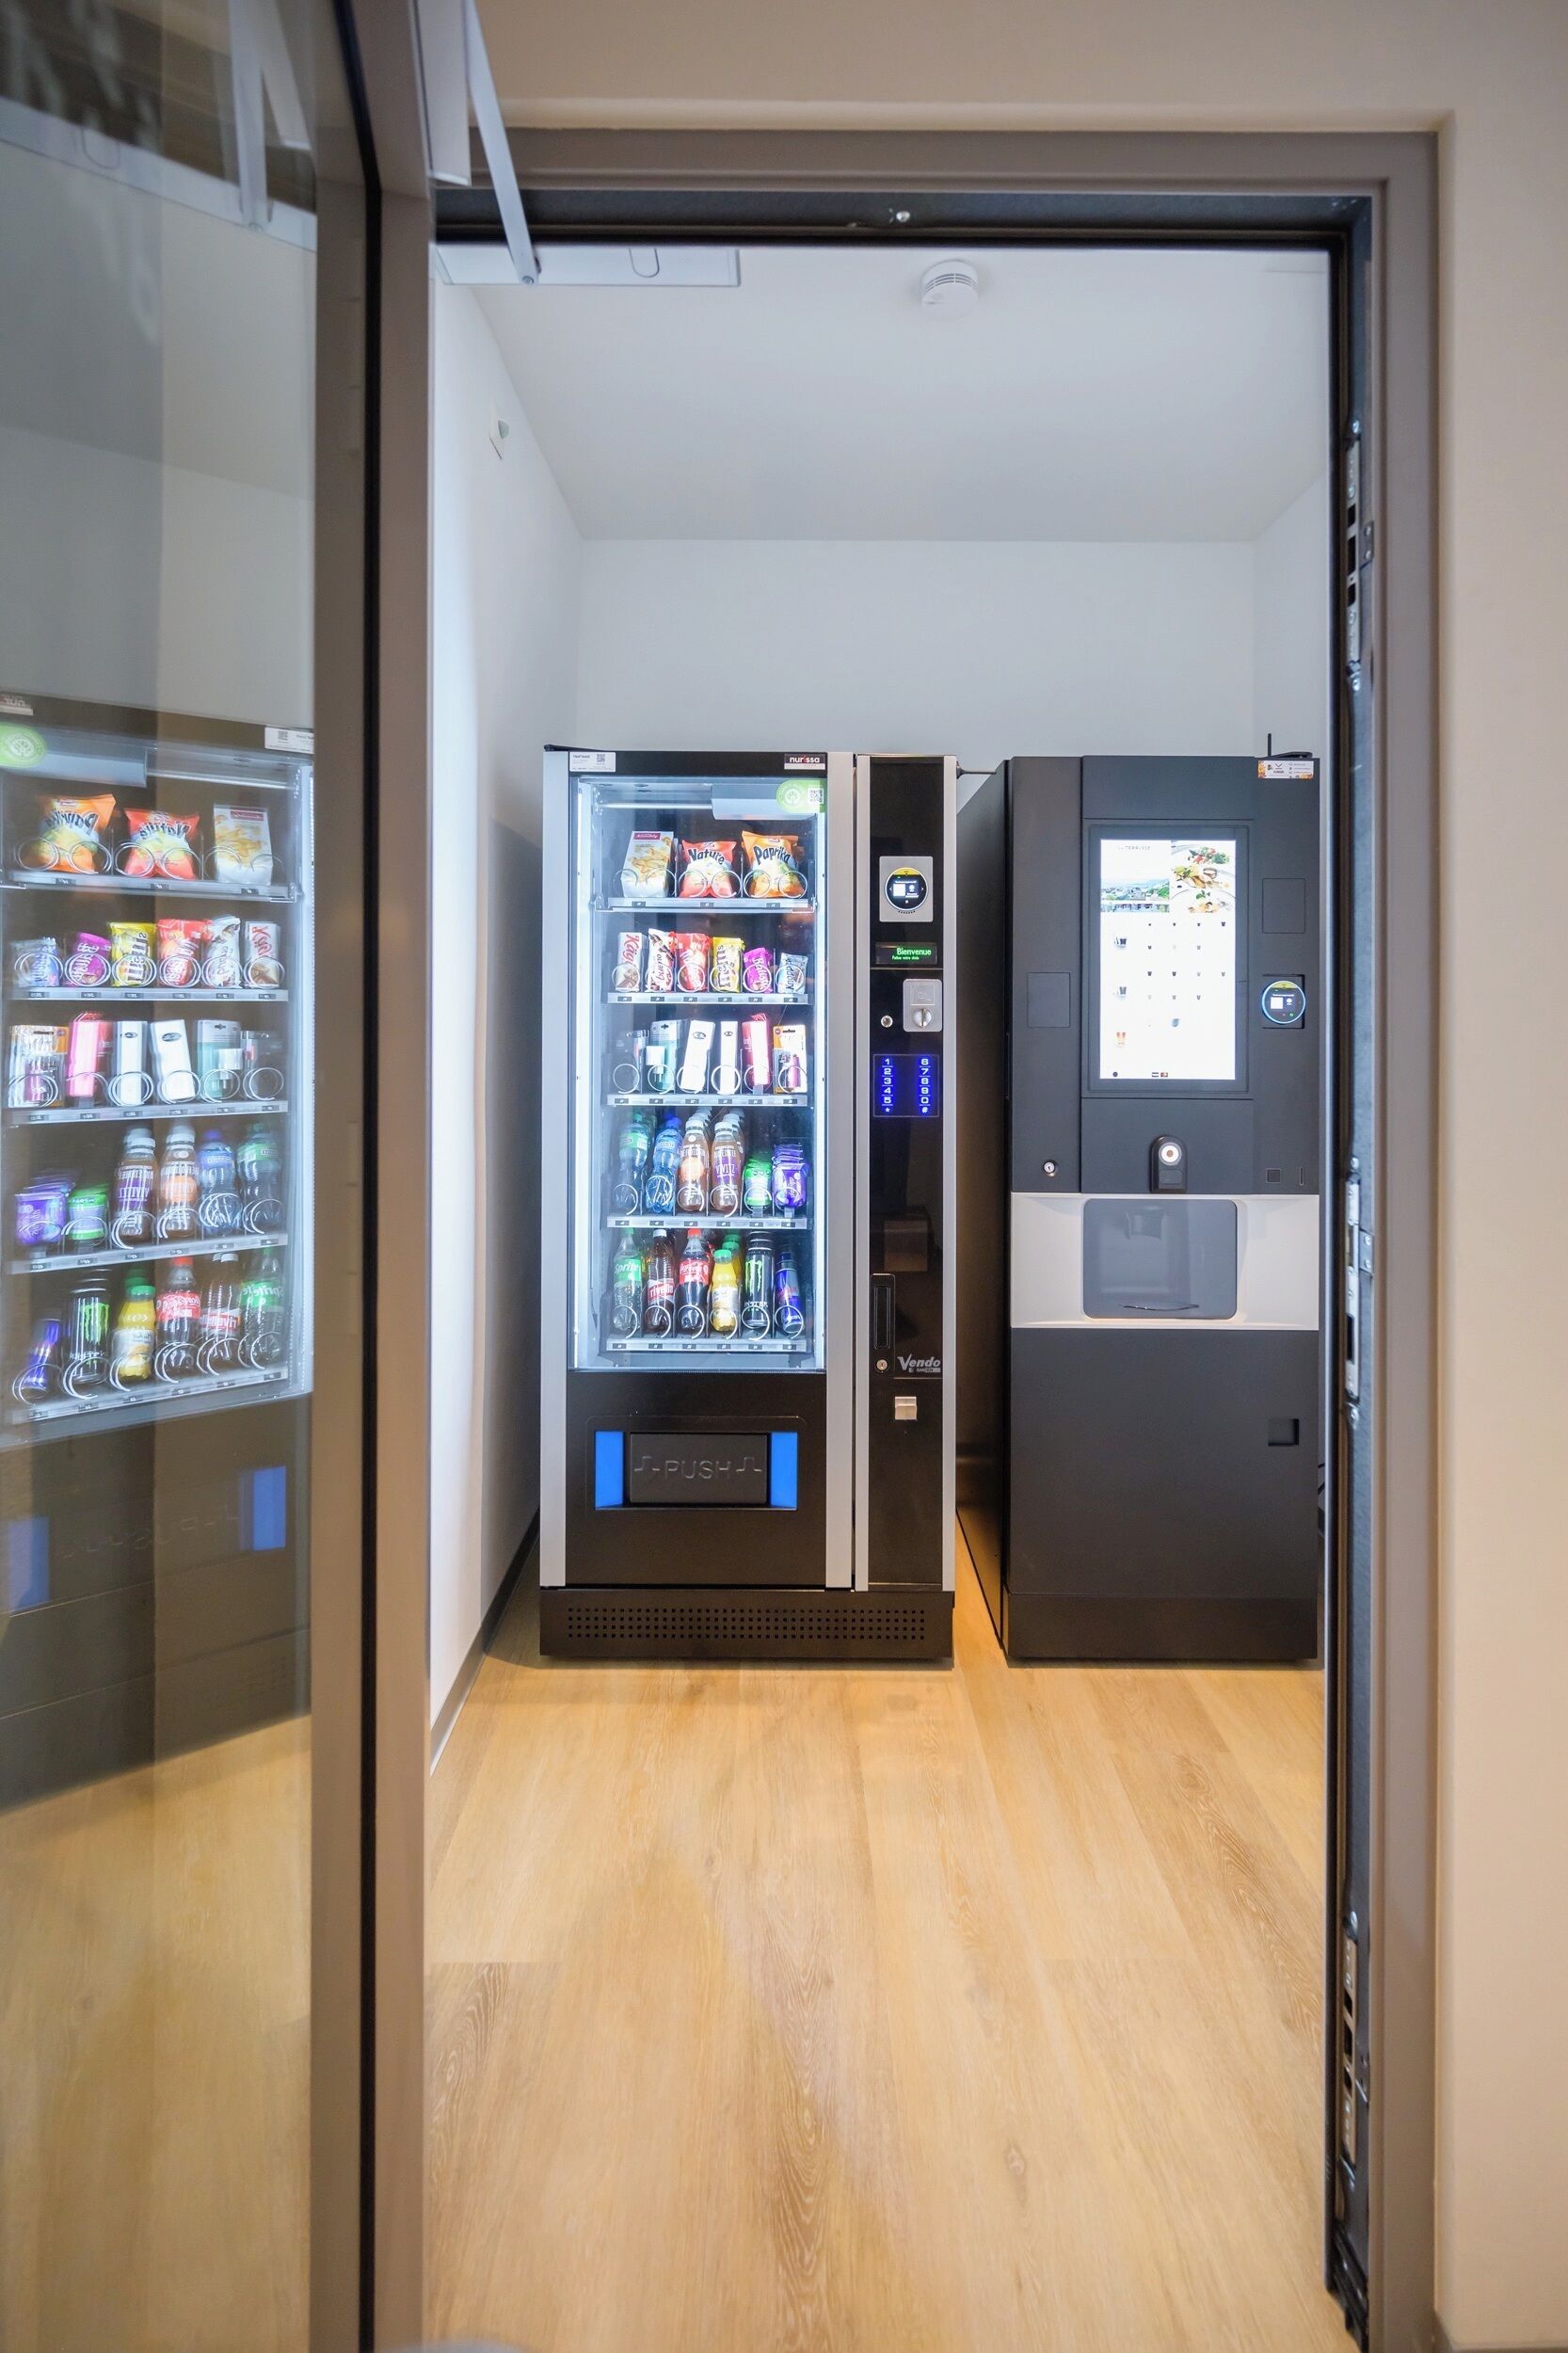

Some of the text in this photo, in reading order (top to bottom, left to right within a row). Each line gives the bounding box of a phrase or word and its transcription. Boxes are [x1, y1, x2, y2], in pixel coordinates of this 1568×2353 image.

[688, 848, 725, 865] Nature
[753, 845, 791, 865] Paprika
[896, 947, 932, 955] Bienvenue
[649, 1283, 674, 1298] rivella
[897, 1353, 941, 1370] Vendo
[664, 1460, 731, 1480] PUSH
